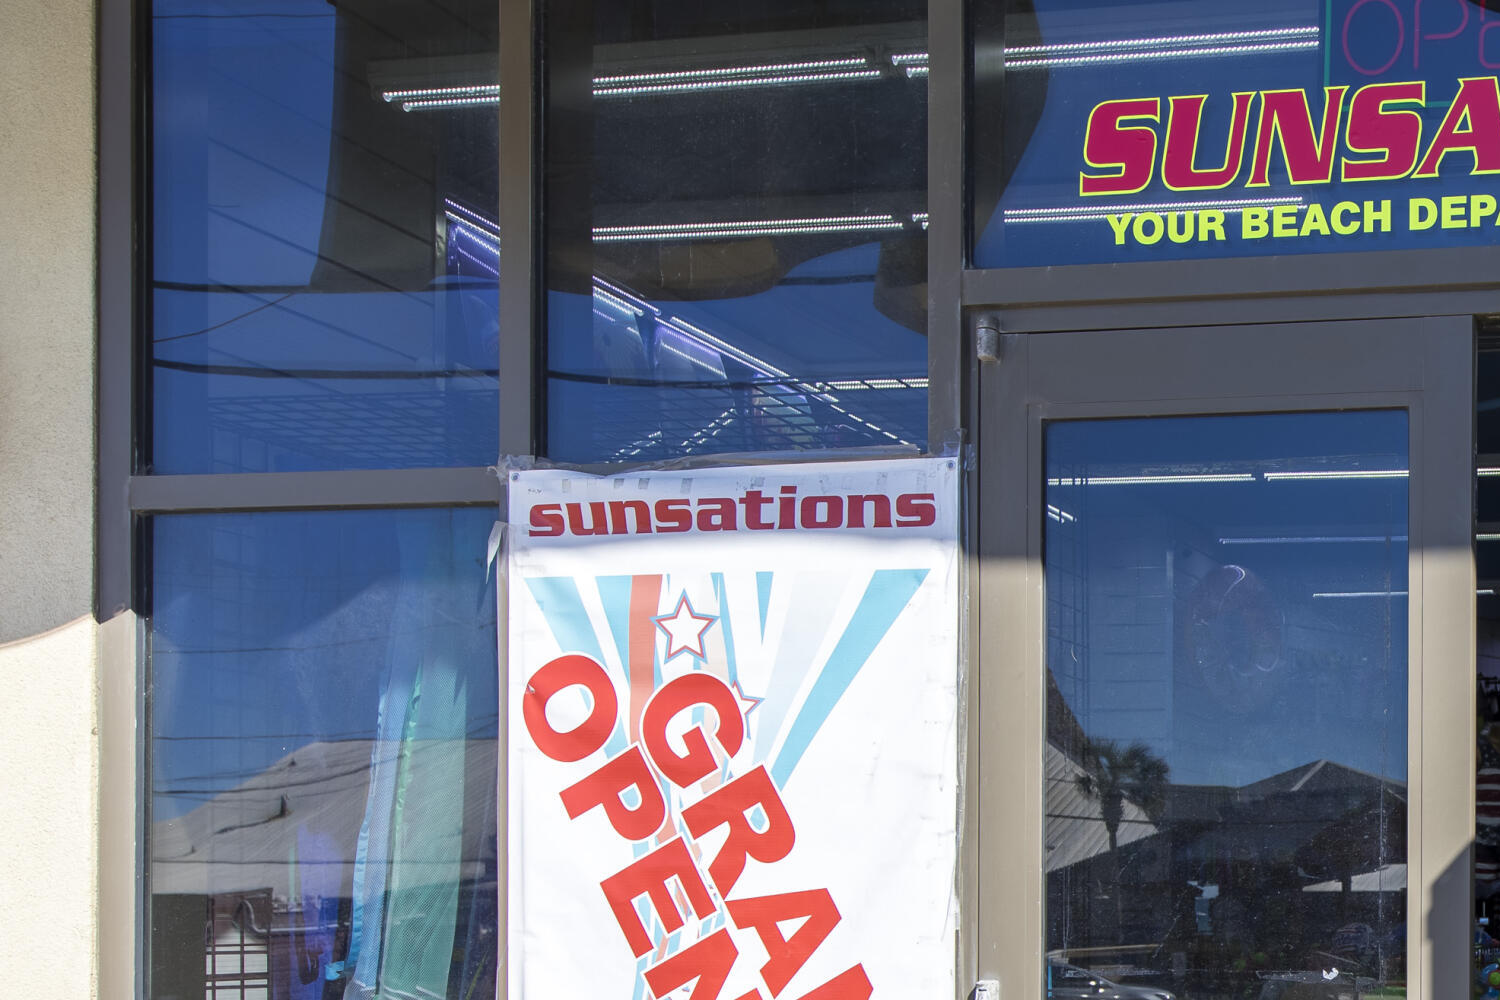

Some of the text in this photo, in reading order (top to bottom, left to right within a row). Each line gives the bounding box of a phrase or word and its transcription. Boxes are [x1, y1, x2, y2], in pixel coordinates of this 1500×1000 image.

[1105, 210, 1226, 244] YOUR
[1242, 199, 1391, 239] BEACH
[528, 485, 937, 538] sunsations
